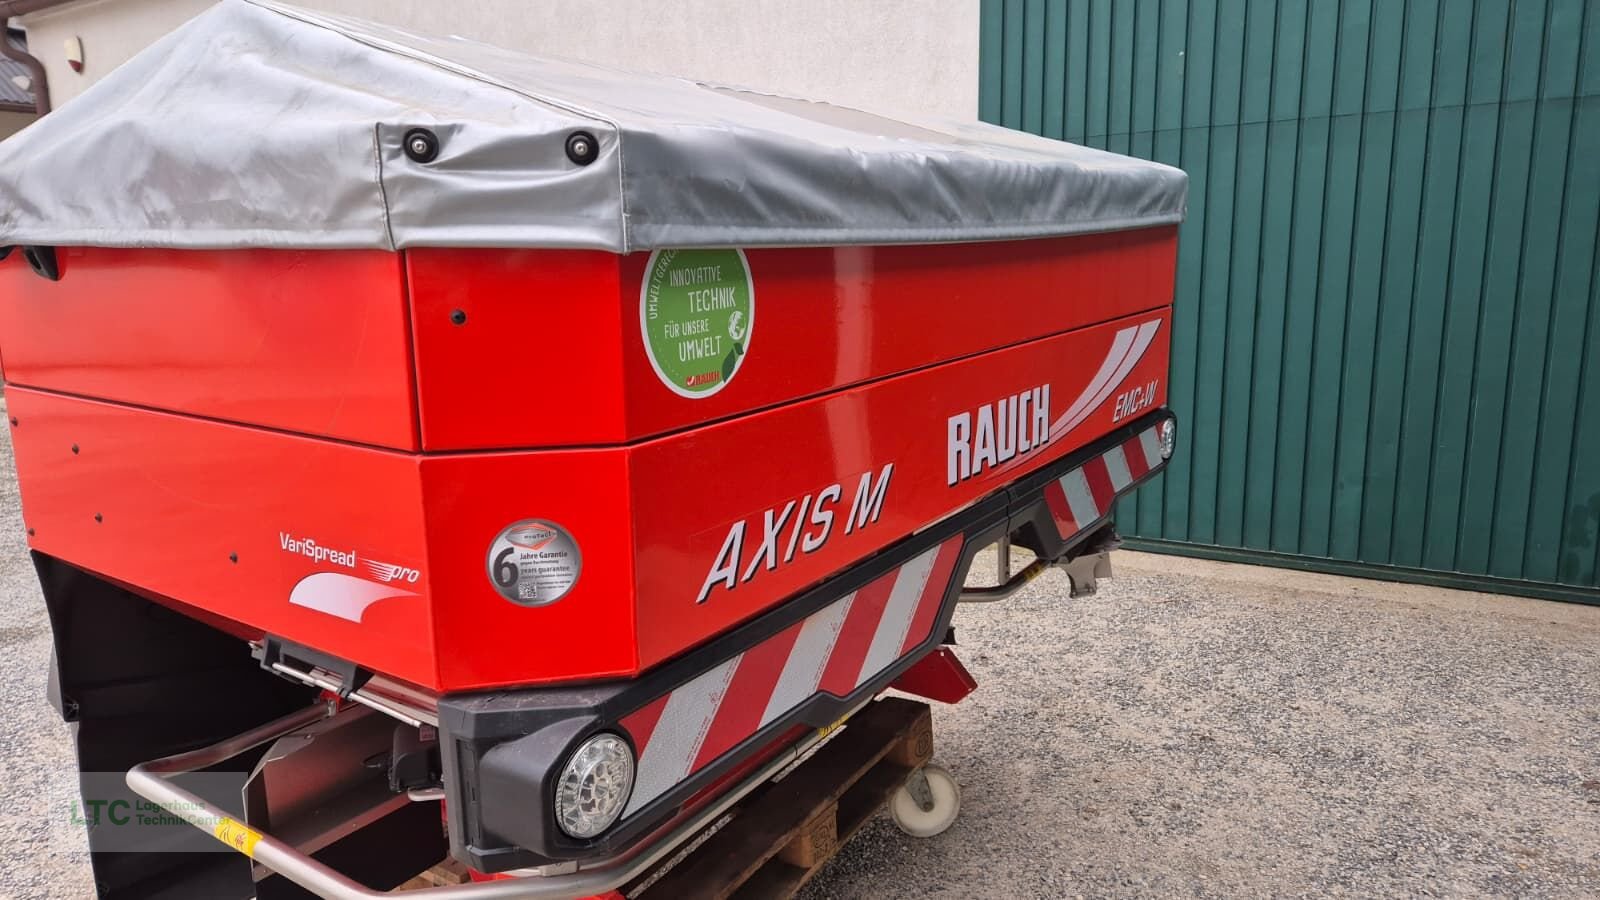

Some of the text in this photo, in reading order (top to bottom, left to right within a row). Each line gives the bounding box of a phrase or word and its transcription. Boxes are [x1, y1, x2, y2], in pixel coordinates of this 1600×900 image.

[669, 265, 722, 288] INNOVATIVE
[687, 287, 737, 314] TECHNIK
[664, 318, 710, 340] FÜR UNSERE
[678, 335, 723, 362] UMWELT
[1111, 379, 1160, 424] EMC+W
[947, 383, 1051, 487] RAUCH
[695, 462, 894, 605] AXIS M
[279, 531, 421, 583] VariSpread pro
[493, 547, 519, 588] 6
[540, 551, 568, 559] Garantie
